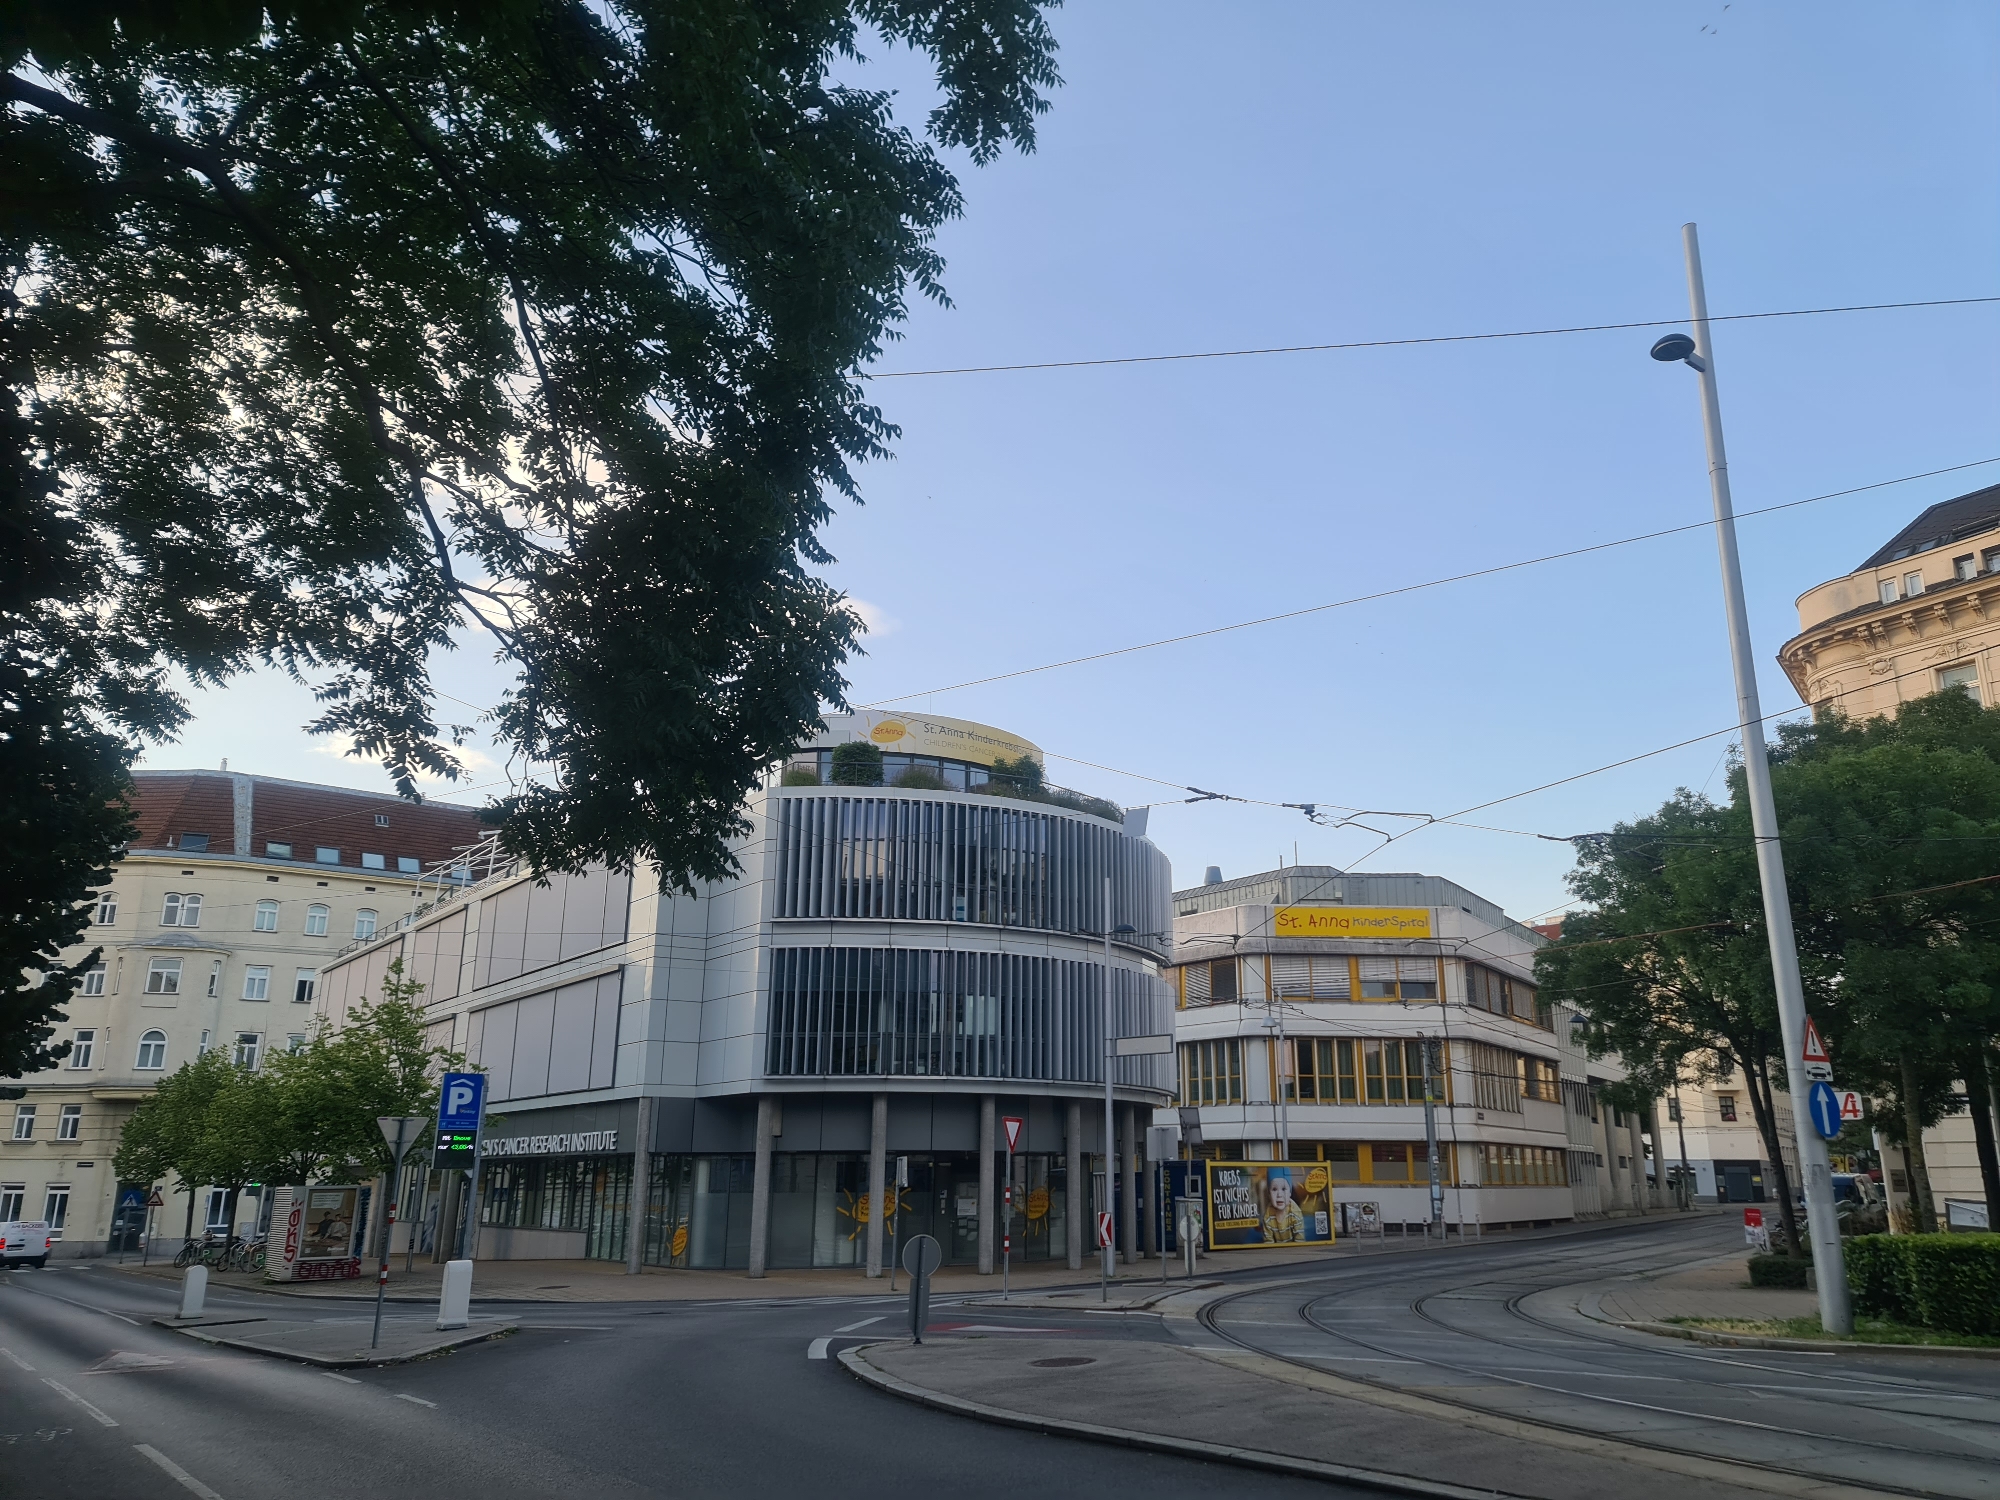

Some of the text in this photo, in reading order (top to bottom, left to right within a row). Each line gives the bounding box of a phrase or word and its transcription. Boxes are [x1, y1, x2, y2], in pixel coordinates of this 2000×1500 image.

[923, 723, 937, 735] St.
[938, 725, 965, 739] Anna
[923, 738, 968, 751] CHILDREN'S
[1277, 913, 1303, 928] St.
[1308, 914, 1349, 929] Anna
[447, 1086, 474, 1115] P
[499, 1137, 529, 1156] CANCER
[530, 1133, 571, 1154] RESEARCH
[571, 1130, 618, 1152] INSTITUTE
[1218, 1169, 1241, 1187] KREBS
[1213, 1187, 1250, 1204] IST NICHTS
